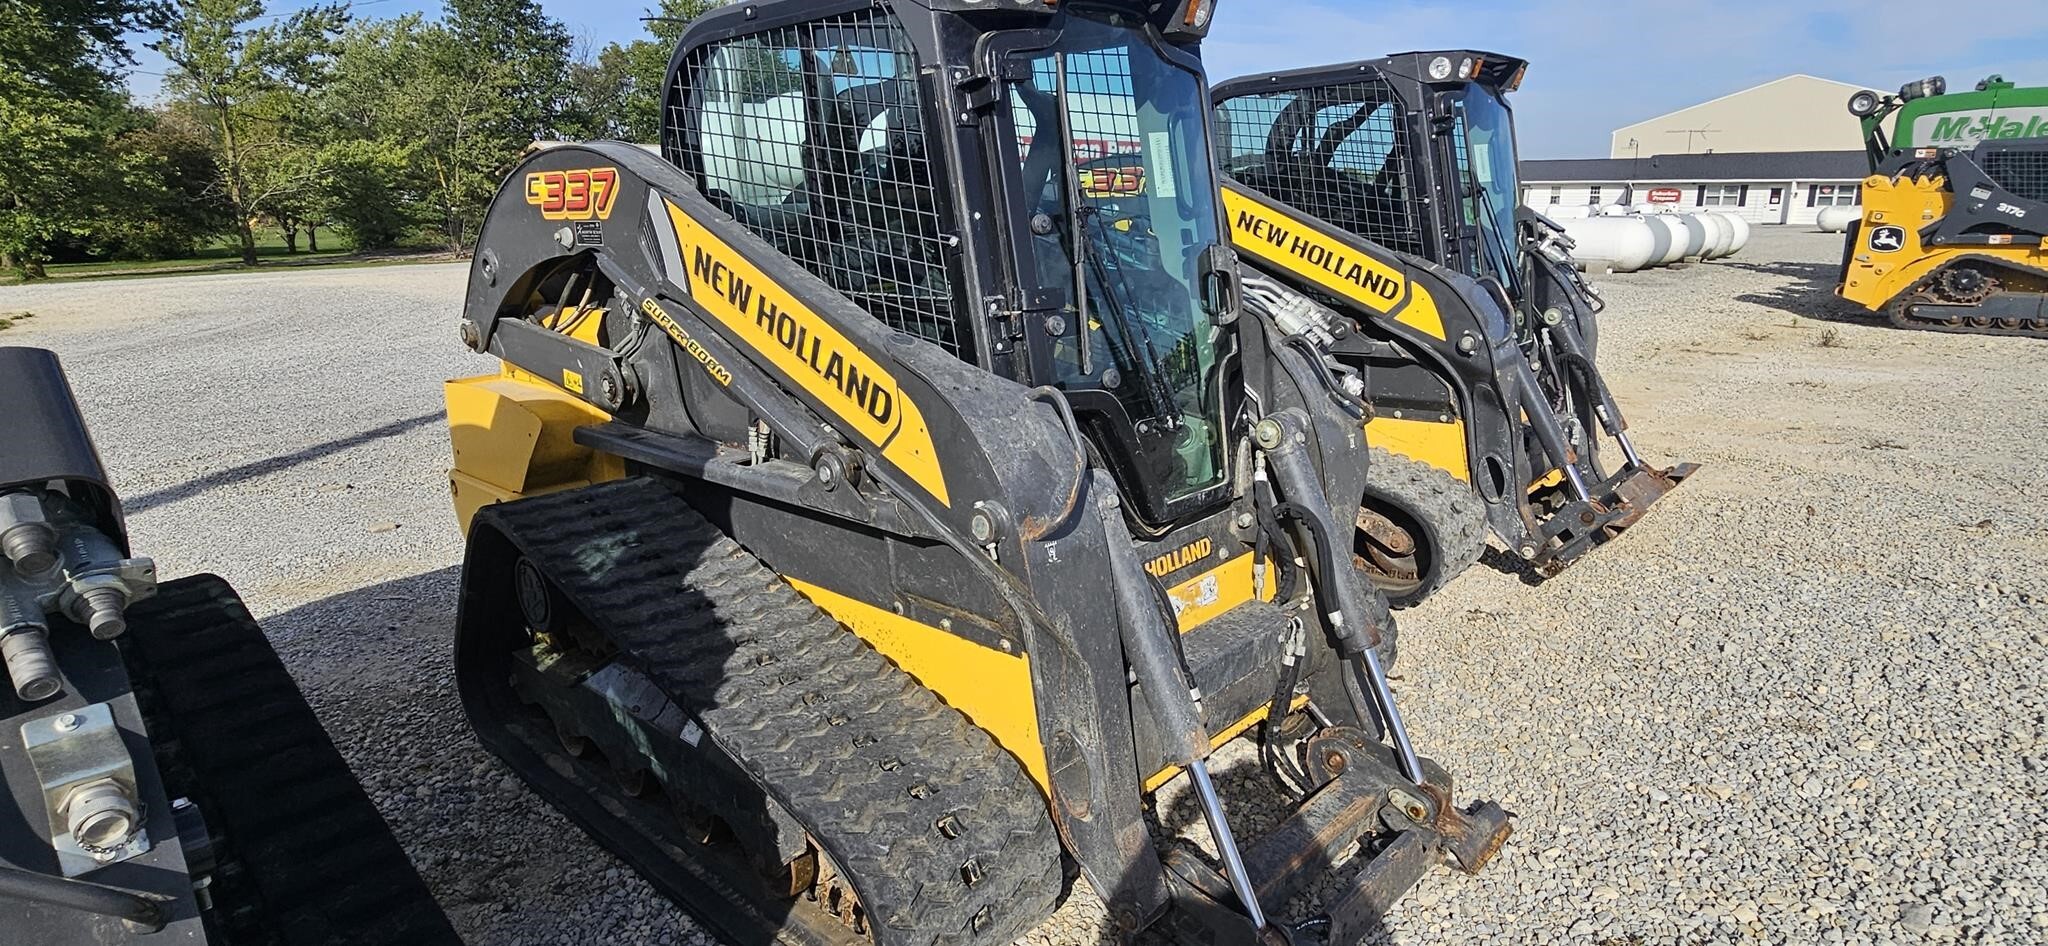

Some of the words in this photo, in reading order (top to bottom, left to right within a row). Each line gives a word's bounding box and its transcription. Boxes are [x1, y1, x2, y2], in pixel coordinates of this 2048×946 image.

[526, 167, 620, 220] C337
[1236, 210, 1289, 247] NEW
[1290, 236, 1399, 300] HOLLAND
[642, 298, 690, 347] SUPER
[687, 339, 732, 386] BOOM
[694, 244, 753, 315] NEW
[756, 293, 893, 426] HOLLAND
[1144, 536, 1212, 577] HOLLAND
